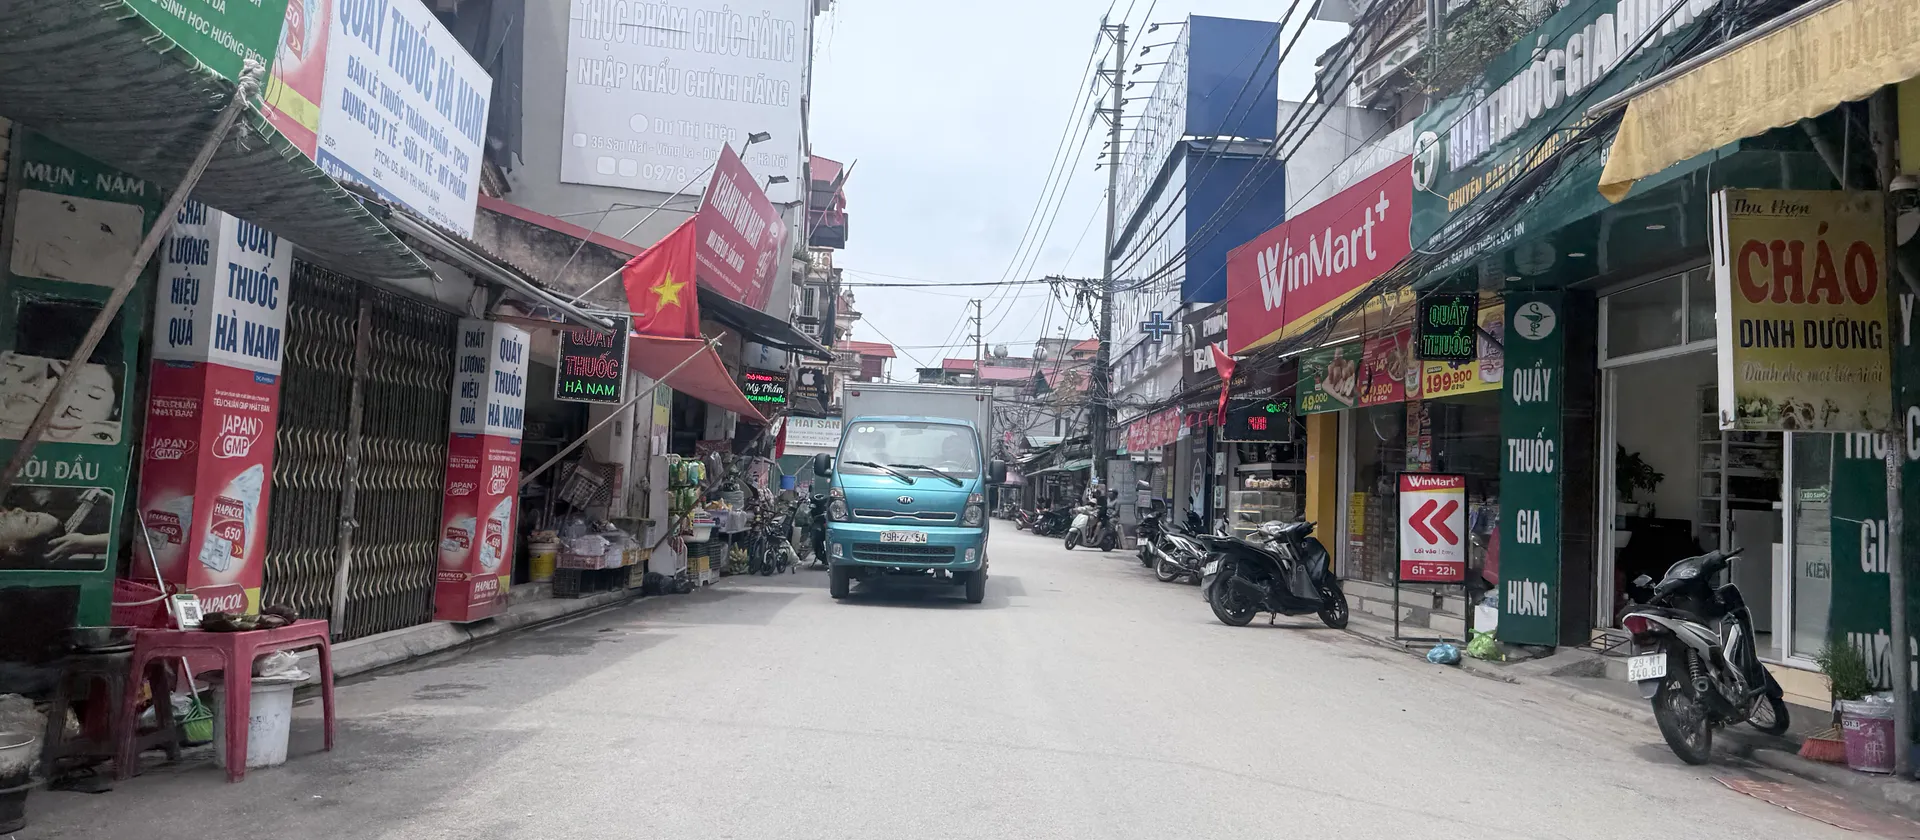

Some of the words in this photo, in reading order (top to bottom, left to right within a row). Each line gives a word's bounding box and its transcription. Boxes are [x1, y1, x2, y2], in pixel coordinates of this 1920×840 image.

[161, 0, 185, 21] SINH
[188, 11, 210, 34] HỌC
[210, 26, 244, 57] HƯỚNG
[581, 0, 628, 50] THỰC
[693, 6, 742, 56] CHỨC
[748, 11, 795, 62] NĂNG
[389, 6, 436, 102] THUỐC
[435, 55, 456, 122] HÀ
[454, 77, 486, 147] NAM
[578, 55, 628, 93] NHẬP
[632, 57, 680, 95] KHẨU
[684, 67, 738, 101] CHÍNH
[742, 74, 790, 107] HÃNG
[1489, 34, 1565, 152] THUỐC
[1565, 13, 1617, 97] GIA
[347, 54, 367, 90] BÁN
[367, 70, 378, 100] LẺ
[380, 89, 405, 121] THUỐC
[405, 104, 429, 142] THÀNH
[429, 127, 449, 158] PHẨM
[453, 146, 470, 175] TPCN
[342, 87, 367, 121] DỤNG
[368, 107, 380, 139] CỤ
[381, 118, 388, 141] Y
[388, 122, 399, 149] TẾ
[403, 135, 418, 164] SỮA
[419, 147, 425, 168] Y
[425, 153, 434, 176] TẾ
[438, 162, 450, 186] MỸ
[449, 172, 468, 201] PHẨM
[678, 120, 700, 141] Thị
[628, 140, 647, 154] Mai
[682, 144, 694, 159] La
[757, 152, 769, 166] Hà
[772, 154, 788, 170] Nội
[23, 161, 75, 184] MỤN
[1448, 176, 1482, 213] CHUYÊN
[1735, 199, 1763, 216] Thu
[1514, 221, 1525, 237] HN
[169, 236, 209, 270] LƯỢNG
[1737, 220, 1879, 305] CHÁO
[171, 272, 200, 311] HIỆU
[228, 262, 279, 310] THUỐC
[169, 310, 193, 347] QUẢ
[215, 309, 237, 353] HÀ
[242, 321, 280, 361] NAM
[1423, 327, 1471, 356] THUỐC
[1740, 318, 1795, 349] DINH
[1803, 314, 1882, 349] DƯỠNG
[460, 355, 485, 377] LƯỢNG
[565, 351, 619, 379] THUỐC
[461, 379, 479, 402] HIỆU
[495, 367, 522, 398] THUỐC
[565, 380, 583, 393] HÀ
[586, 382, 615, 396] NAM
[745, 383, 761, 395] Mỹ
[762, 383, 786, 395] Phẩm
[1426, 370, 1472, 394] 199.900
[220, 414, 257, 436] JAPAN
[488, 400, 500, 426] HÀ
[502, 406, 523, 430] NAM
[152, 438, 187, 449] JAPAN
[156, 449, 181, 459] GMP
[223, 436, 249, 457] GMP
[1508, 427, 1554, 474] THUỐC
[54, 454, 100, 481] ĐẦU
[491, 465, 510, 479] JAPAN
[214, 503, 244, 519] HAPACOL
[898, 496, 912, 504] KIA
[225, 526, 242, 541] 650
[1516, 509, 1542, 544] GIA
[1412, 565, 1426, 575] 6h
[1436, 566, 1456, 575] 22h
[1630, 666, 1664, 681] 340.80
